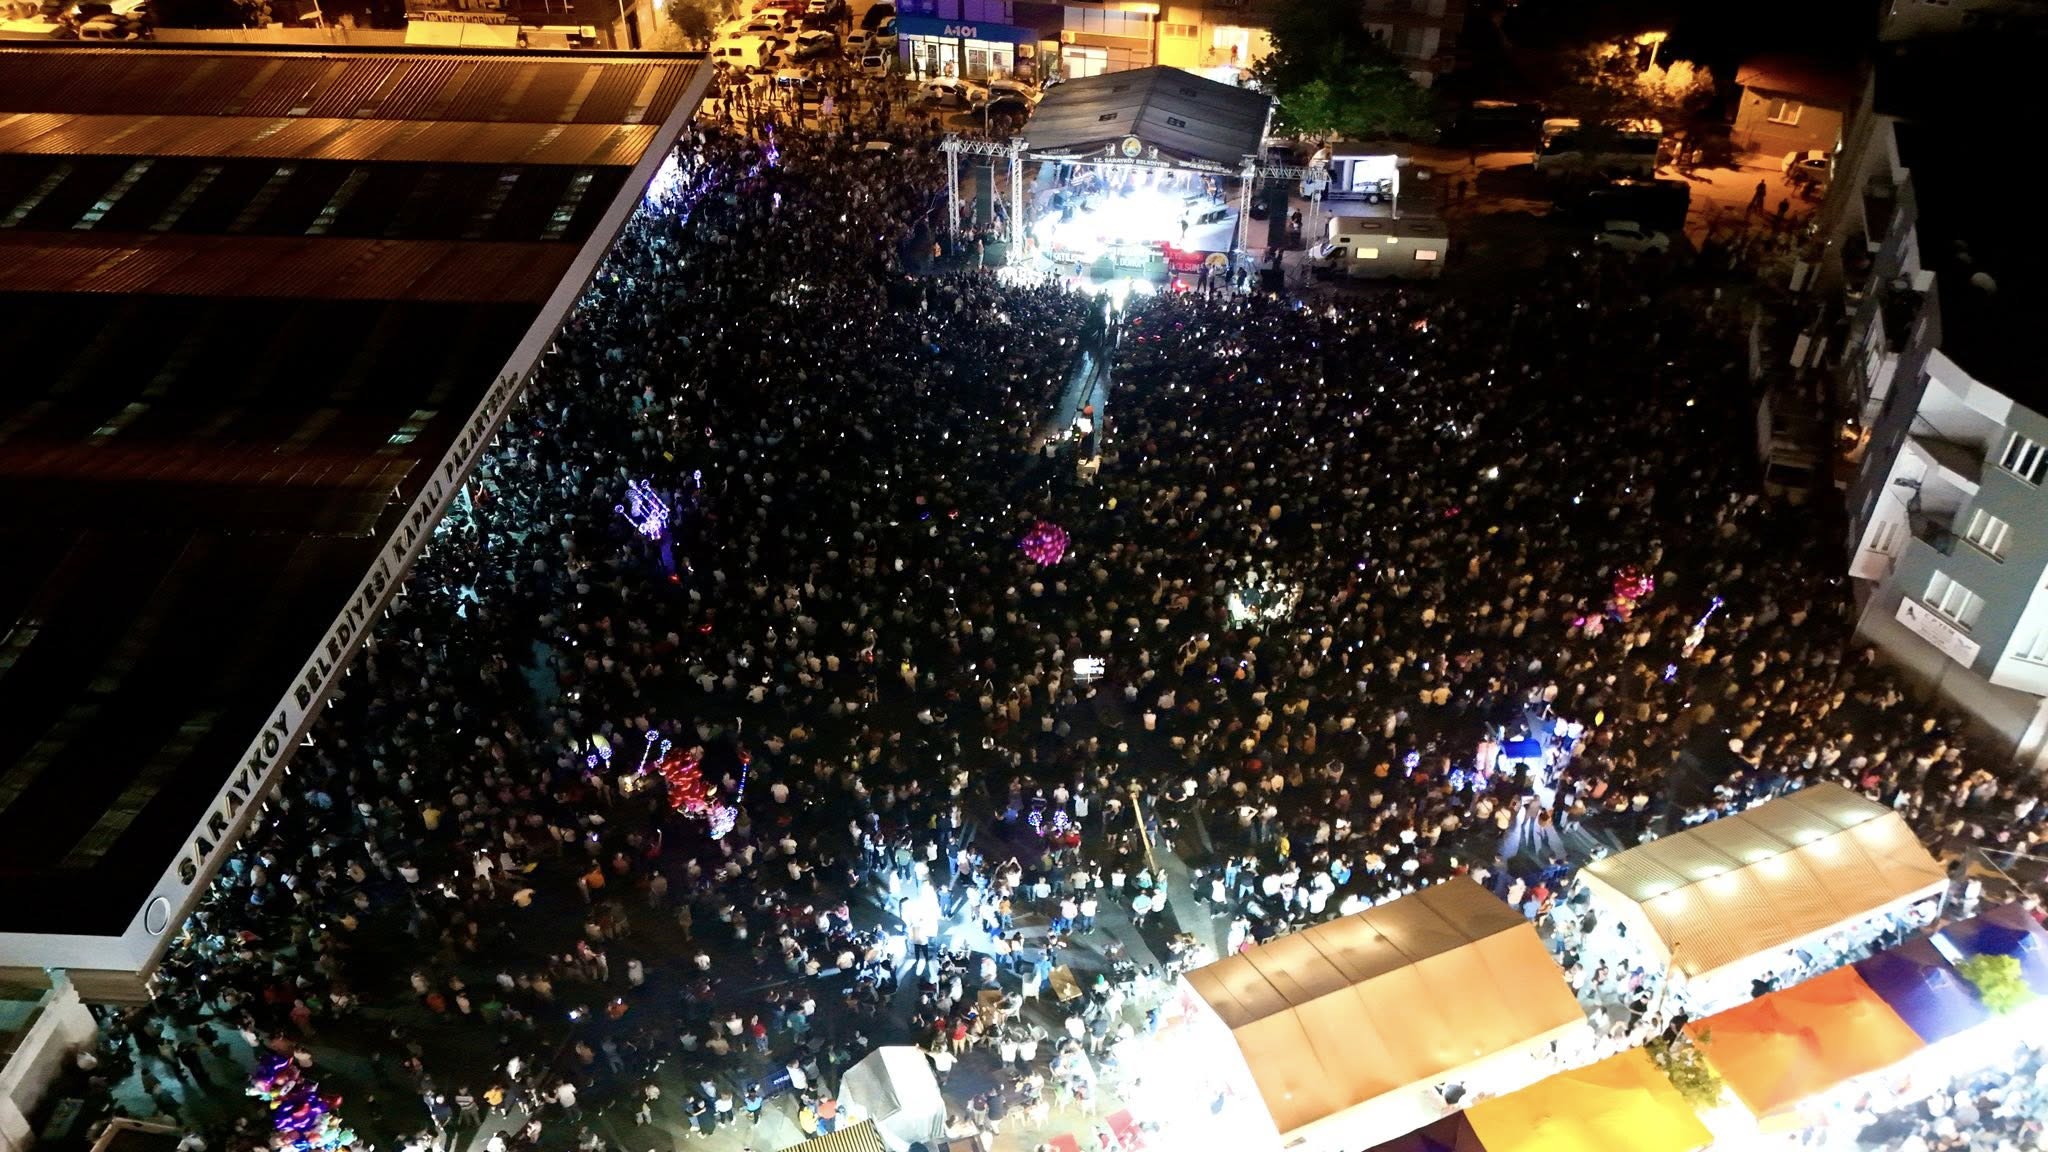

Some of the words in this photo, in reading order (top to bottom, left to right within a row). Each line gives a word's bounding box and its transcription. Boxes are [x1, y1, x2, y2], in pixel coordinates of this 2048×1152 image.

[177, 711, 289, 886] SARAYKÖY
[293, 557, 391, 711] BELEDİYESİ
[392, 480, 443, 563] KAPALI
